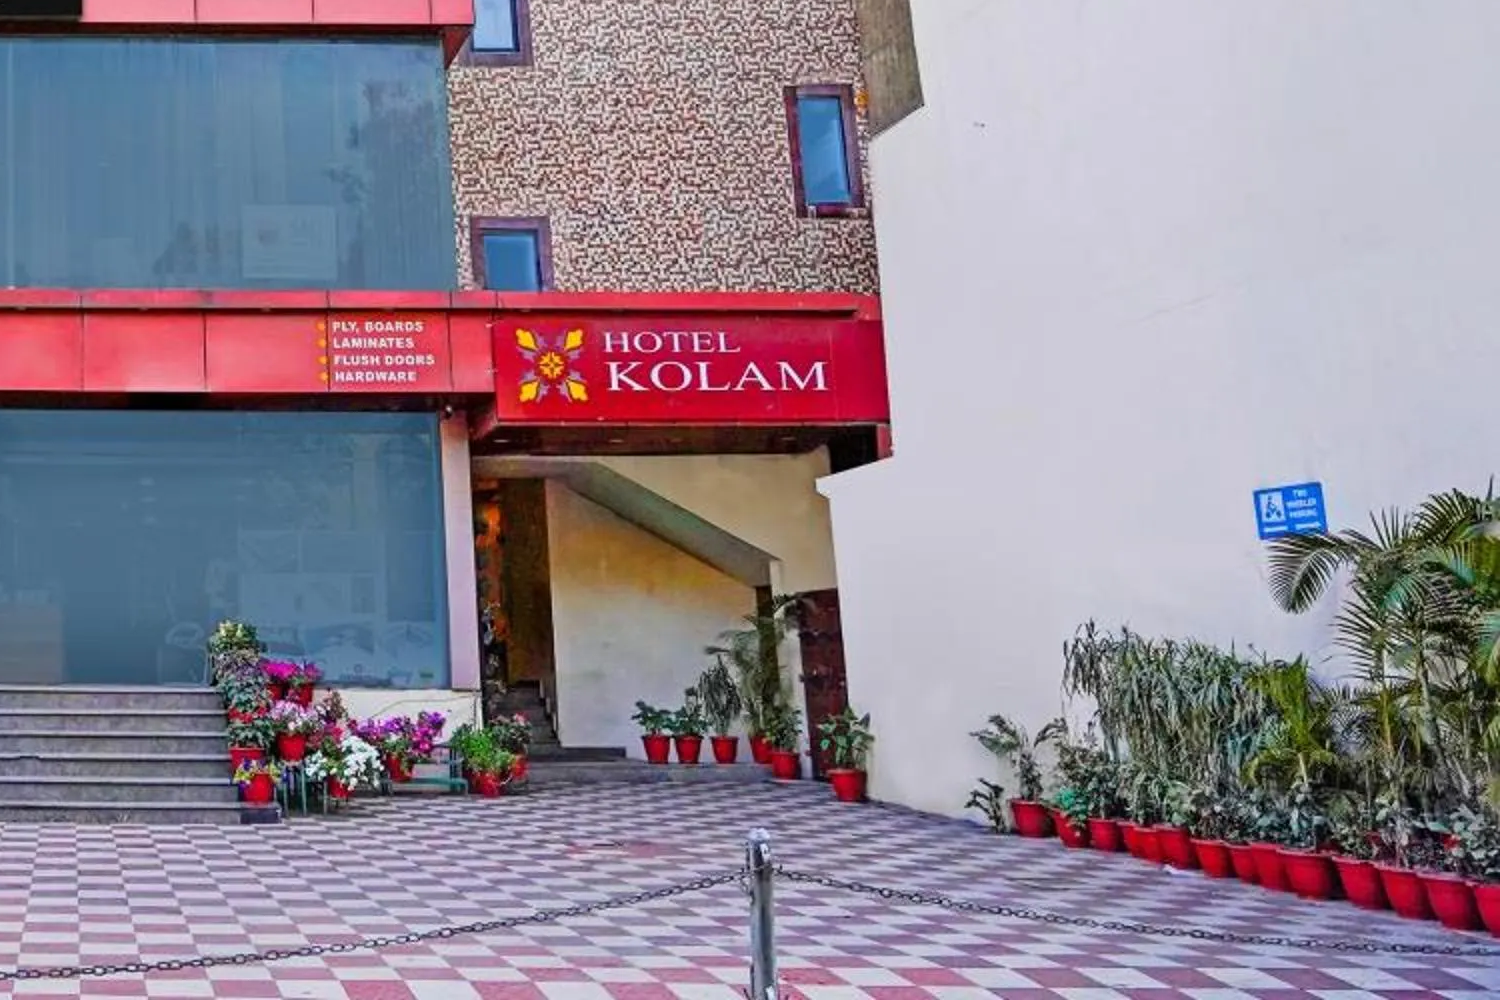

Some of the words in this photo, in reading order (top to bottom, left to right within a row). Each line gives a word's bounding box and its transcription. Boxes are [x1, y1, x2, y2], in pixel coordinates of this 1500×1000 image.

[365, 321, 425, 332] BOARDS
[333, 338, 415, 349] LAMINATES
[603, 331, 741, 353] HOTEL
[333, 354, 381, 365] FLUSH
[384, 354, 436, 365] DOORS
[335, 371, 417, 382] HARDWARE
[606, 360, 829, 391] KOLAM
